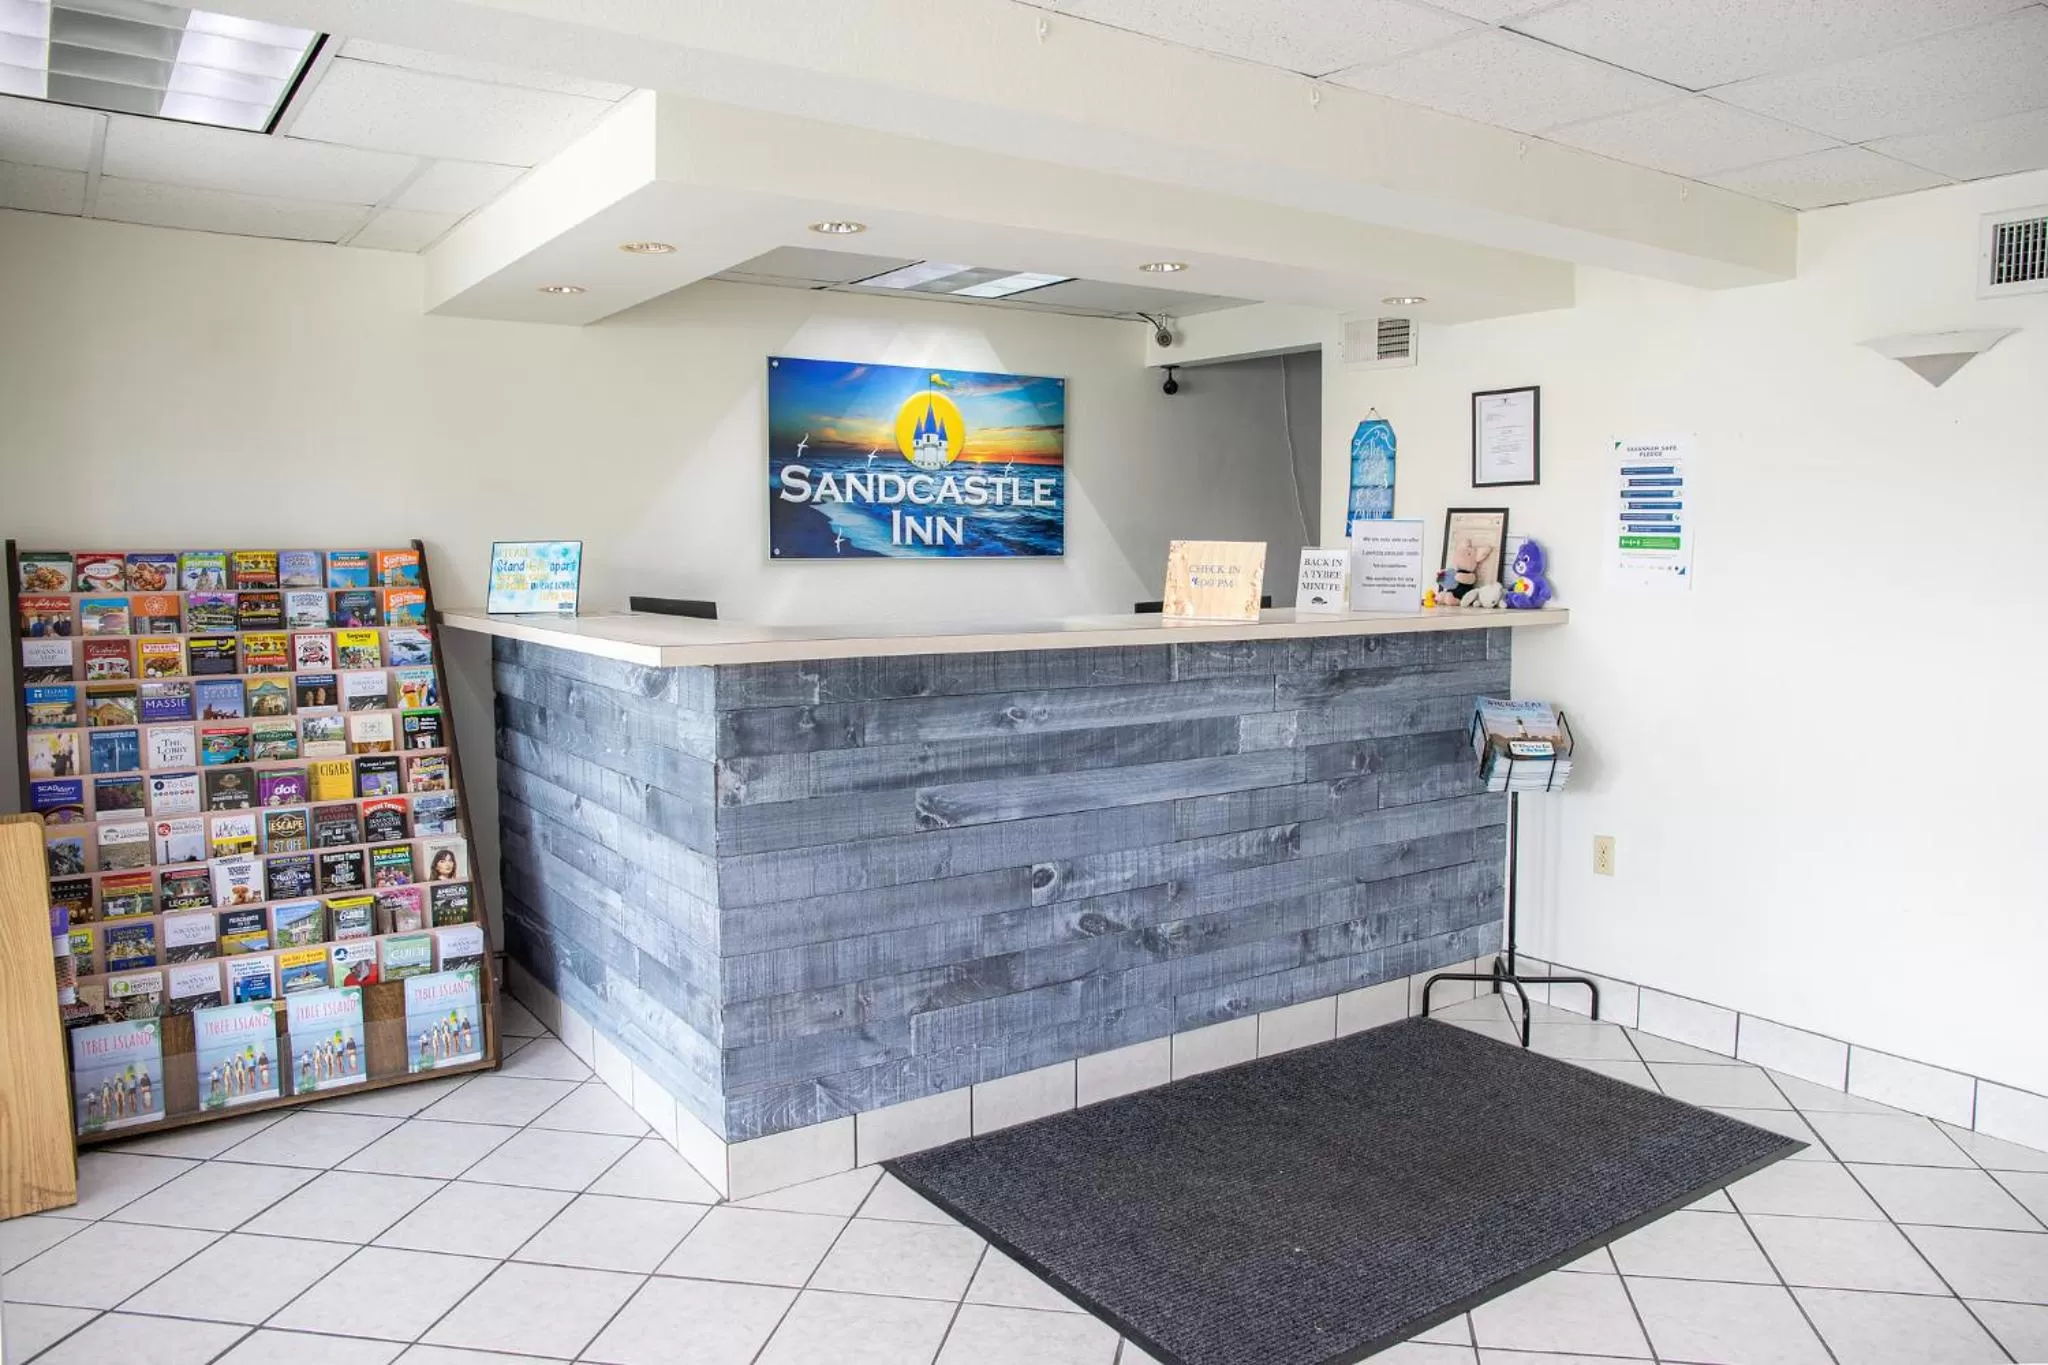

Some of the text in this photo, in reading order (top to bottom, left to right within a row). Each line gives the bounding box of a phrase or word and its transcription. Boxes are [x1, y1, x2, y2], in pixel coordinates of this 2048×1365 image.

[780, 465, 1057, 507] SANDCASTLE
[890, 510, 964, 546] INN
[496, 560, 577, 575] Stand apart
[1304, 558, 1343, 567] BACK IN
[1189, 565, 1241, 574] CHECK IN
[1302, 571, 1342, 580] A TYBEE
[1301, 582, 1341, 592] MINUTE
[145, 698, 188, 709] MASSIE
[320, 762, 351, 775] CIGARS
[274, 783, 298, 797] dot
[270, 819, 304, 832] ESCAPE
[168, 896, 210, 908] LEGENDS
[323, 999, 357, 1017] ISLAND
[204, 1013, 269, 1036] TYBEE ISLAND
[80, 1031, 153, 1055] TYBEE ISLAND
